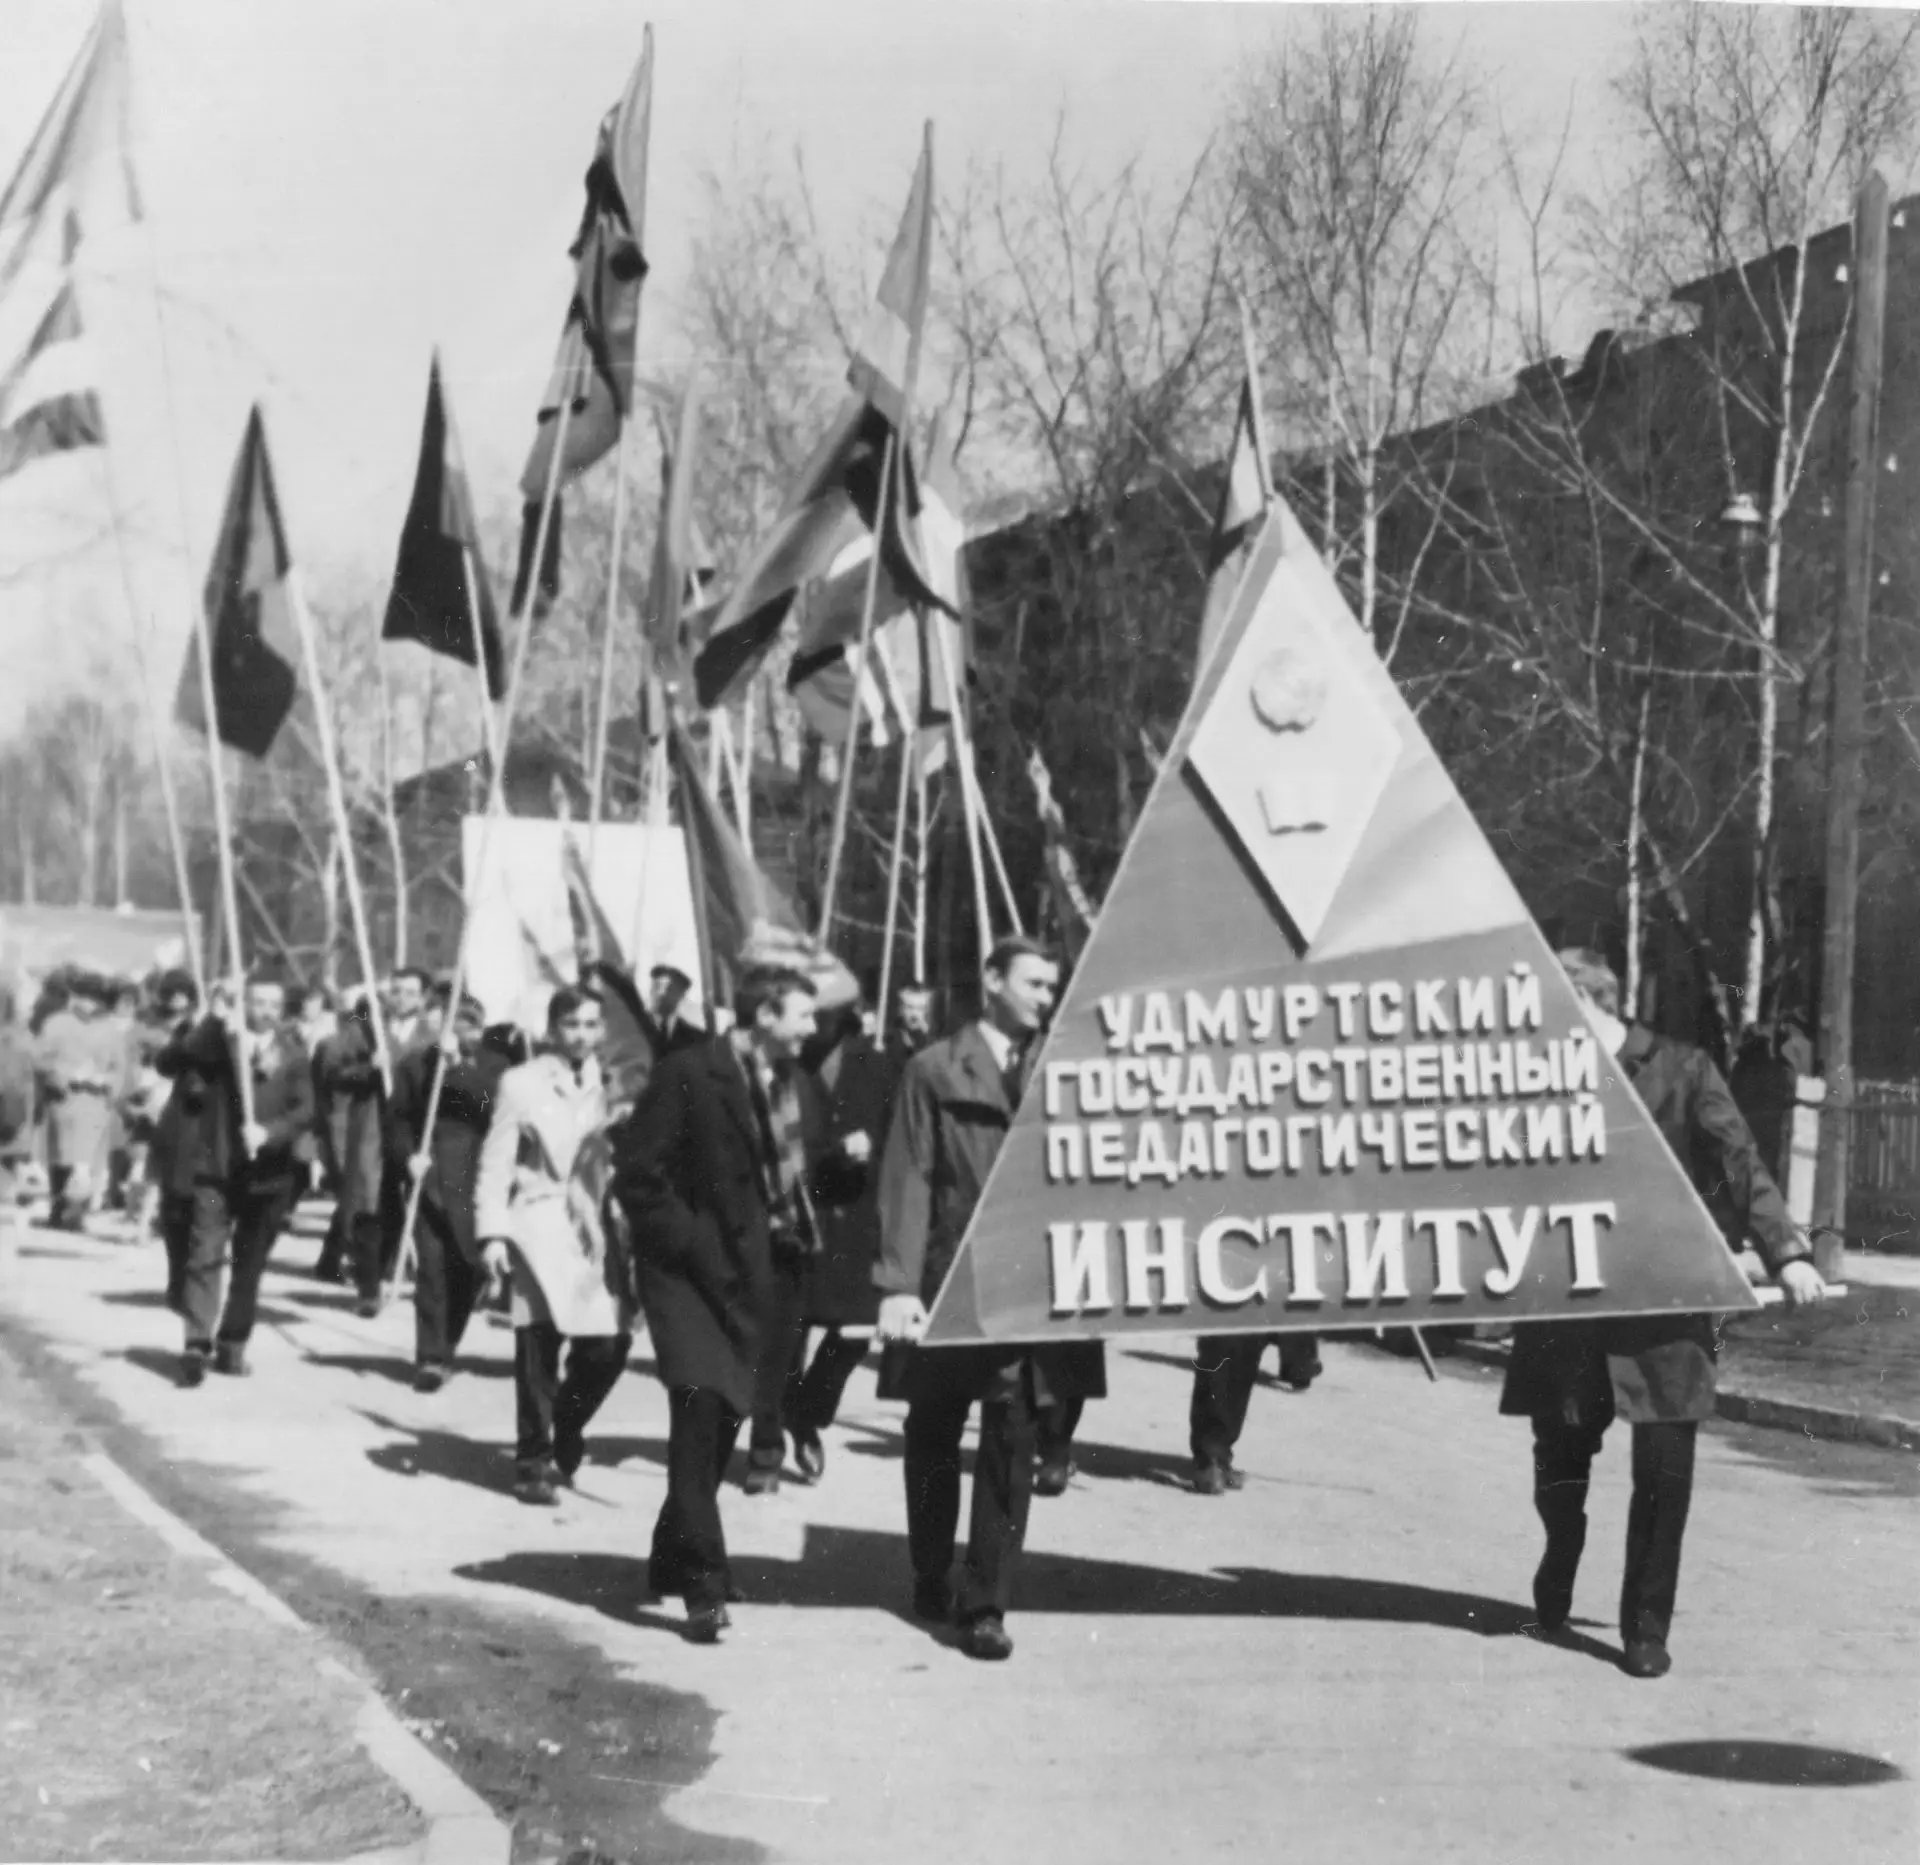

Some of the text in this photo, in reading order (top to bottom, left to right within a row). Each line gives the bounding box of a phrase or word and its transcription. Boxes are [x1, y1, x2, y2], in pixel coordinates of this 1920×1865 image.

[1099, 962, 1543, 1052] УДМУРТСКИЙ
[1045, 1027, 1598, 1115] ГОСУДАРСТВЕННЫЙ
[1047, 1093, 1607, 1184] ПЕДАГОГИЧЕСКИЙ
[1049, 1201, 1617, 1312] ИНСТИТУТ
